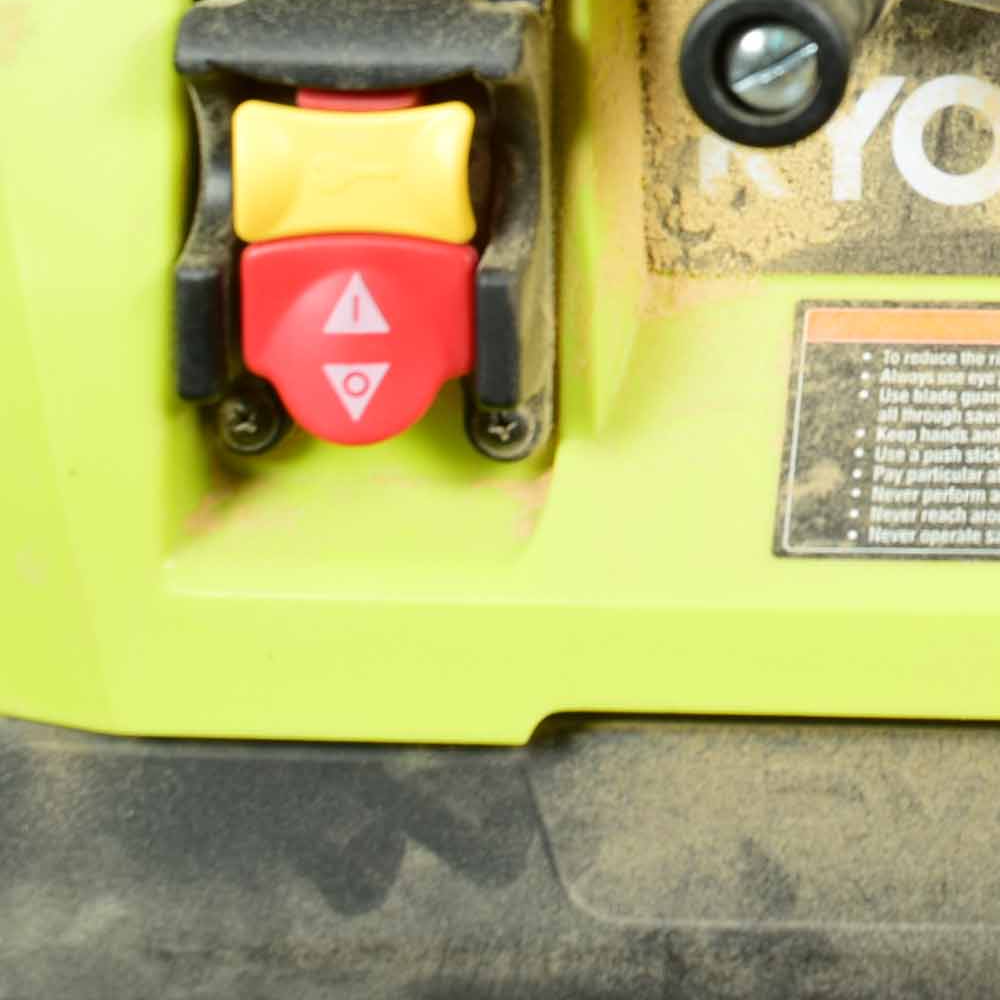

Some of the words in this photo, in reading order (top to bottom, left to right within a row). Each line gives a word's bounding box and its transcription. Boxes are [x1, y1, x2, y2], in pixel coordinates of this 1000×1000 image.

[883, 351, 900, 366] To
[903, 352, 957, 367] reduce
[960, 351, 986, 367] the
[880, 389, 909, 404] Use
[913, 389, 958, 404] blade
[876, 427, 916, 445] Keep
[919, 427, 969, 444] hands
[868, 527, 917, 544] Never
[919, 529, 984, 547] operate
